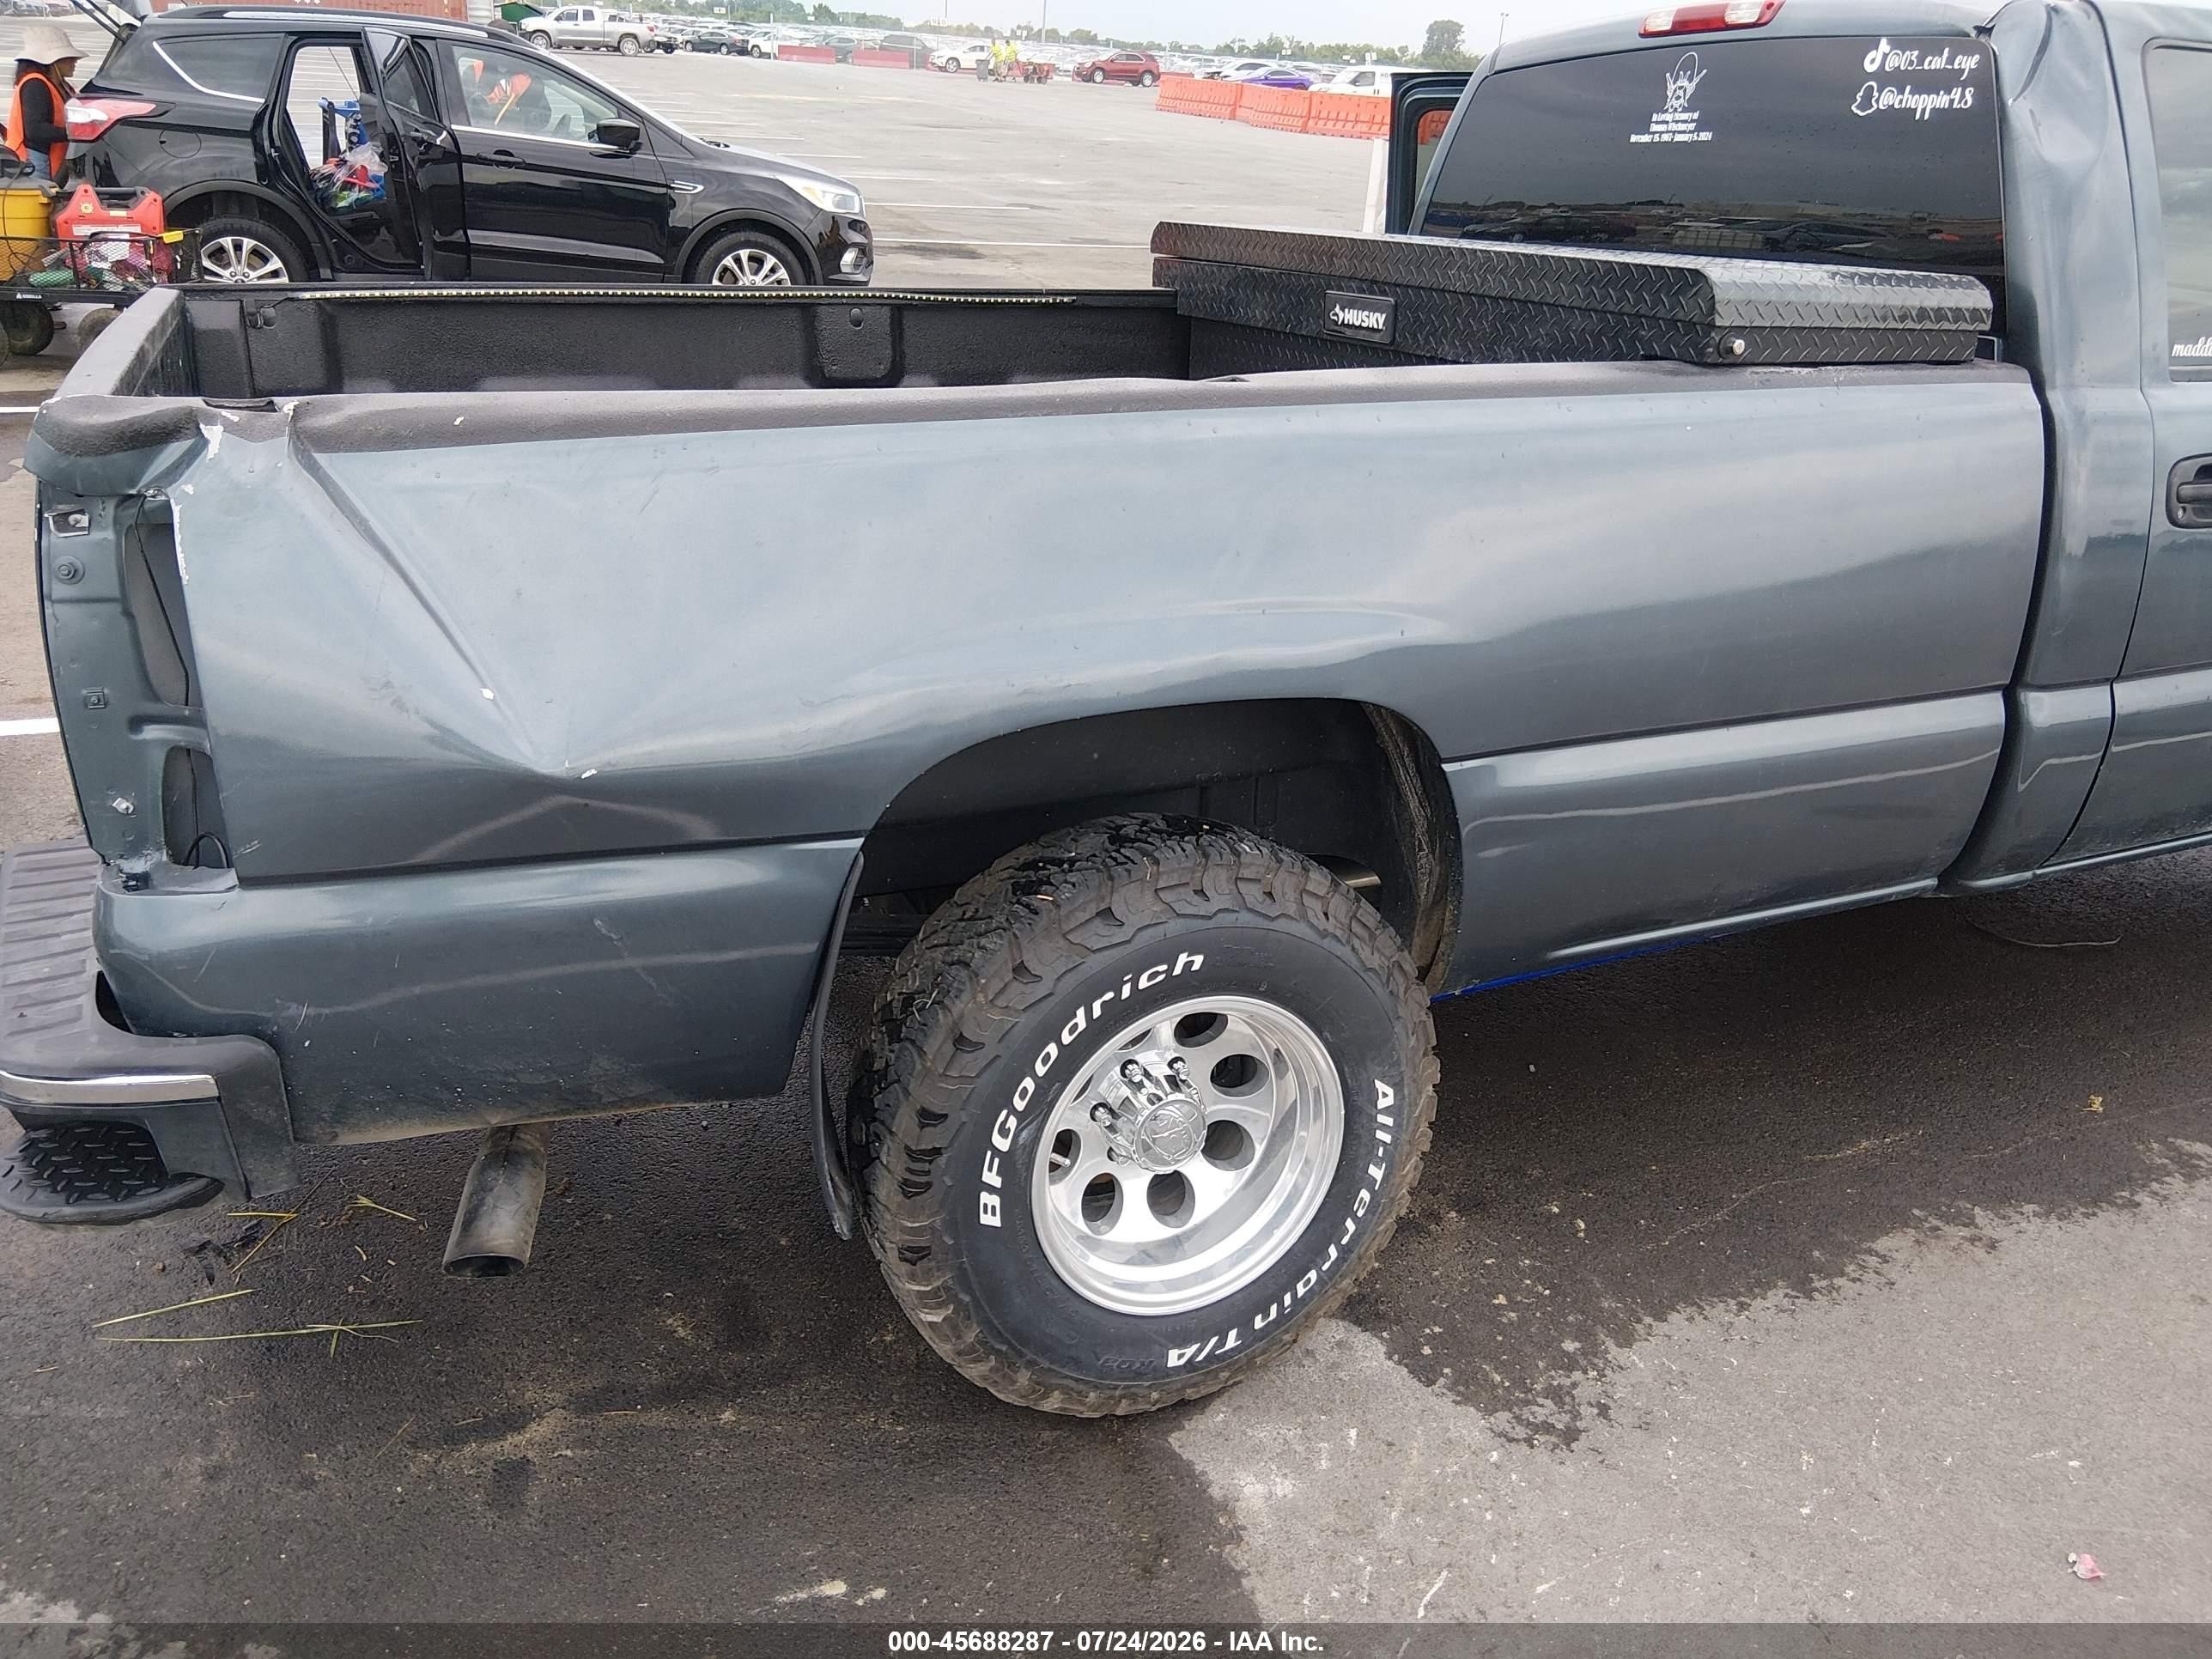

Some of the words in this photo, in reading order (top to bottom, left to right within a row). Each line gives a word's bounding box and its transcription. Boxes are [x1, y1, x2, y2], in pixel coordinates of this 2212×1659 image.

[1885, 48, 1980, 81] @03_cat_eye
[1879, 85, 1974, 121] @choppin4.8
[980, 951, 1204, 1227] BFGoodrich
[1167, 1328, 1243, 1368] T/A
